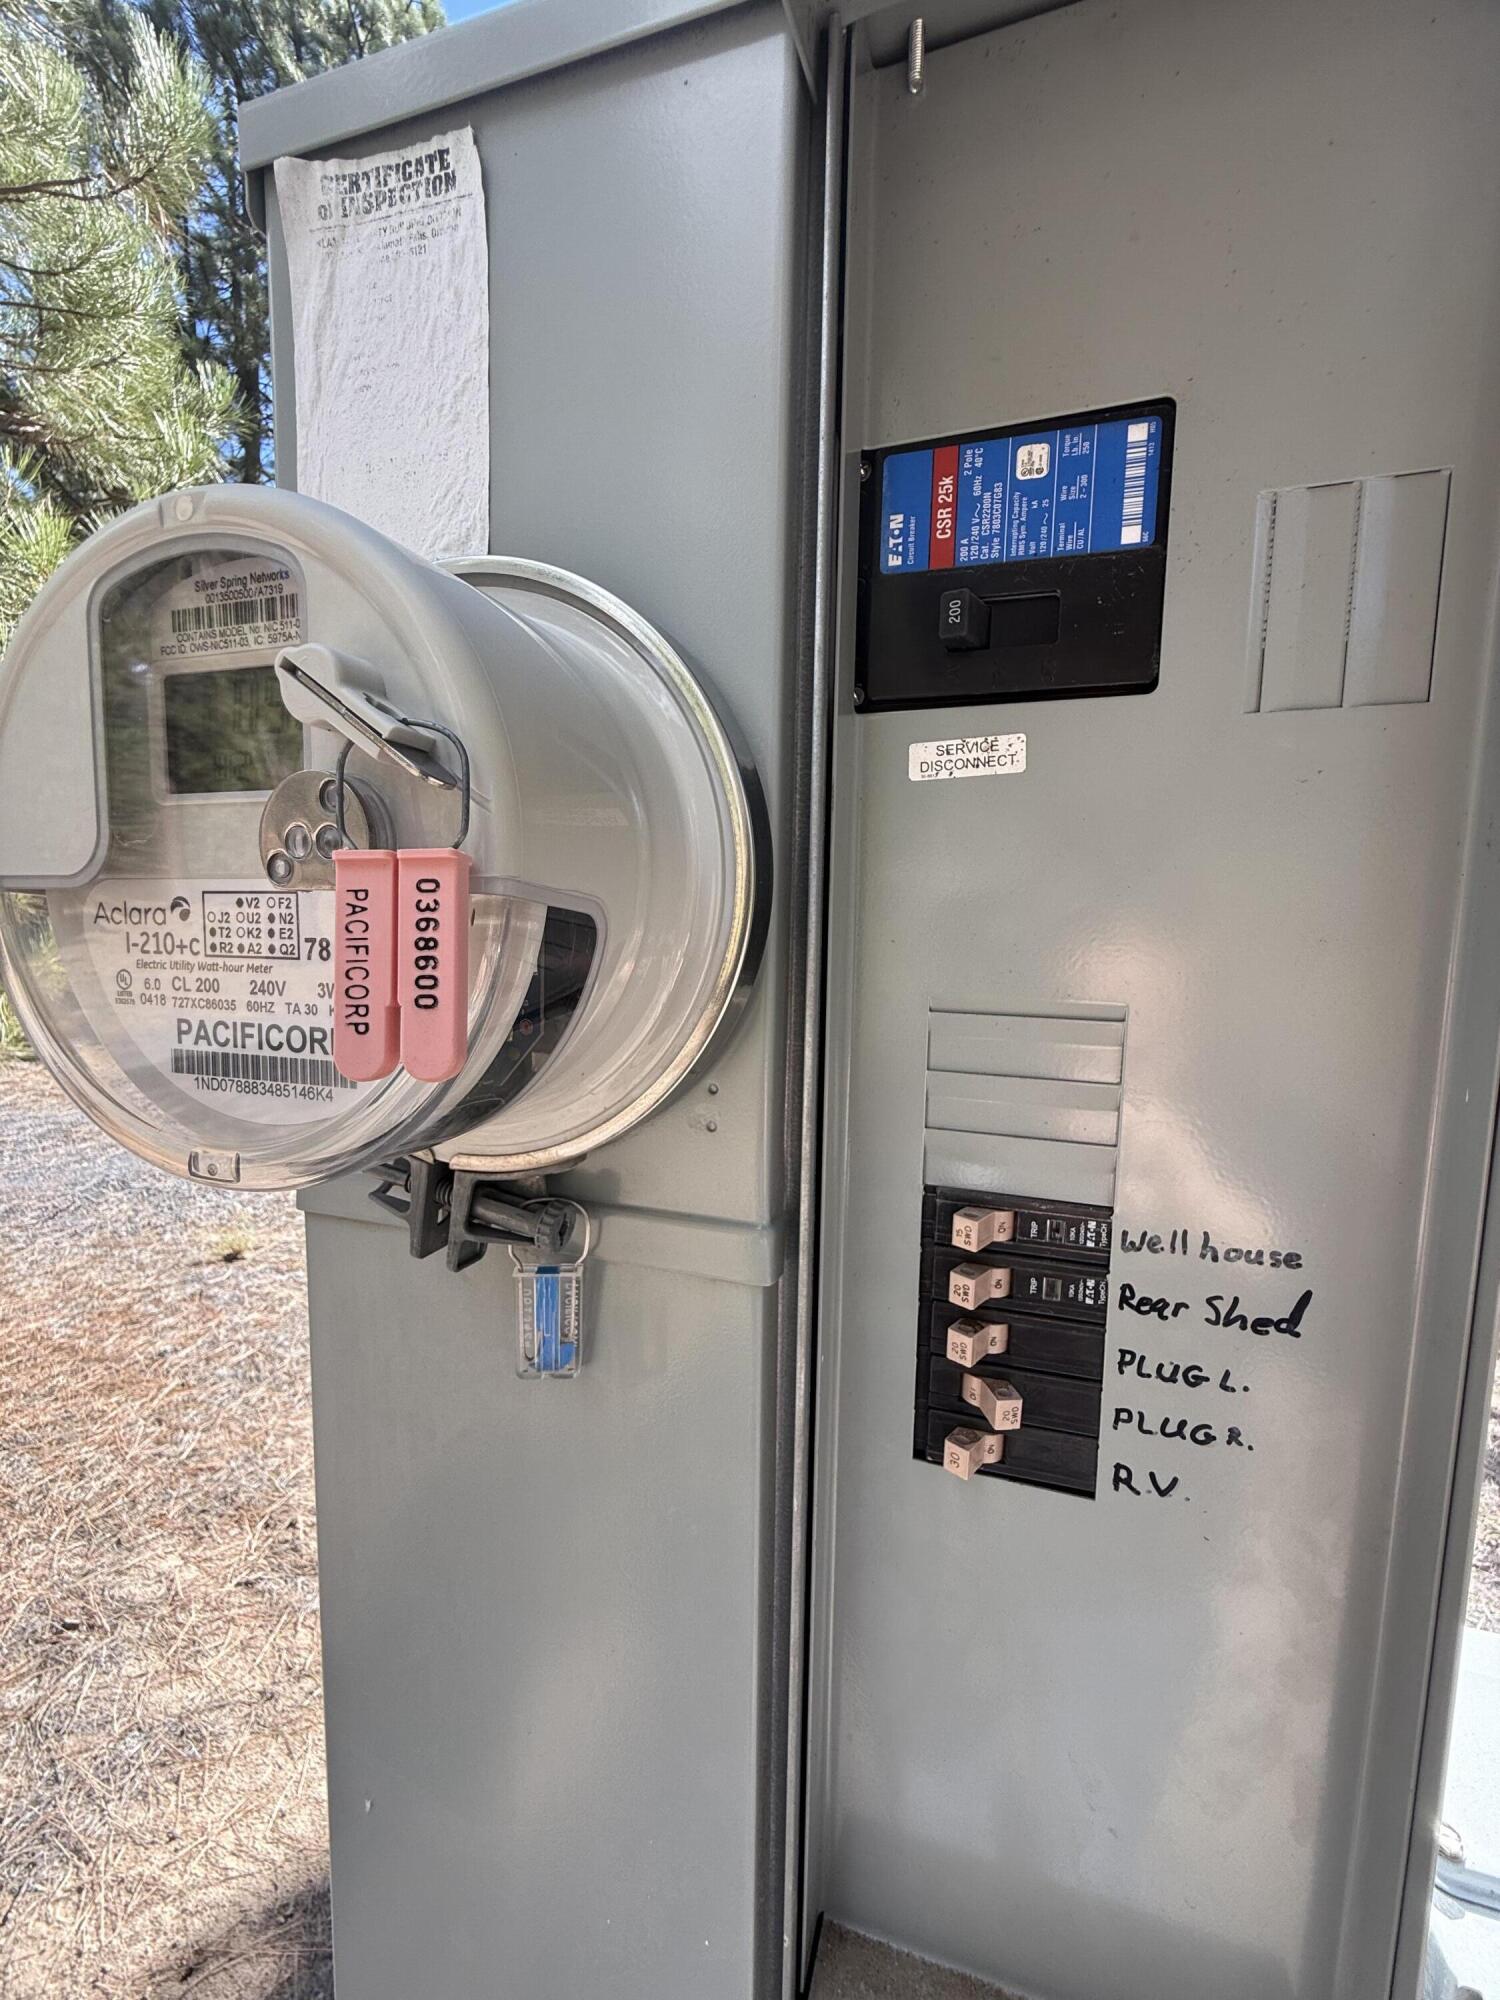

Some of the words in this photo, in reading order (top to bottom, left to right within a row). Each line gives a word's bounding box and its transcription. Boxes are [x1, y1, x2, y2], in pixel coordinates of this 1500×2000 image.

[320, 147, 451, 197] CERTIFICATE
[341, 169, 457, 219] INSPECTION
[1062, 434, 1072, 456] Torque
[964, 449, 973, 468] Pole
[974, 447, 984, 468] 40°C
[938, 475, 954, 502] 25k
[973, 475, 982, 496] 60Hz
[1060, 486, 1068, 500] Wire
[1068, 486, 1077, 500] Size
[1077, 528, 1085, 549] CU/AL
[1082, 441, 1090, 454] 250
[982, 492, 992, 535] CSR2200N
[992, 482, 1003, 534] 7803C07G83
[1012, 492, 1021, 518] Capacity
[1020, 497, 1029, 521] Ampere
[1030, 500, 1038, 508] kA
[1042, 499, 1049, 507] 25
[908, 516, 916, 541] Breaker
[936, 508, 952, 539] CSR
[888, 514, 904, 566] EATON
[970, 526, 980, 560] 120/240
[1010, 520, 1020, 556] Interrupting
[1039, 526, 1048, 552] 120/240
[1056, 523, 1066, 550] Terminal
[1066, 534, 1074, 550] Wire
[907, 543, 916, 564] Circuit
[960, 546, 968, 561] 200
[980, 543, 990, 559] Cat.
[991, 538, 1001, 558] Style
[1018, 540, 1026, 555] RMS
[1029, 541, 1037, 554] Volt
[194, 580, 218, 592] Silver
[220, 575, 248, 590] Spring
[250, 568, 290, 584] Networks
[949, 600, 961, 623] 200
[176, 630, 218, 643] CONTAINS
[219, 626, 248, 638] MODEL
[160, 646, 178, 656] FCC
[936, 739, 1000, 757] SERVICE
[920, 753, 1017, 773] DISCONNECT
[94, 900, 166, 926] Aclara
[246, 896, 260, 909] V2
[278, 896, 292, 910] F2
[218, 912, 231, 924] J2
[246, 912, 262, 924] U2
[279, 912, 294, 925] N2
[218, 926, 232, 939] T2
[247, 927, 262, 939] K2
[279, 928, 294, 940] E2
[220, 942, 234, 954] R2
[247, 942, 262, 954] A2
[279, 944, 296, 956] Q2
[304, 938, 332, 962] 78
[414, 878, 441, 1010] 0368600
[136, 959, 168, 970] Electric
[170, 960, 195, 973] Utility
[198, 961, 244, 973] Watt-hour
[246, 963, 274, 974] Meter
[344, 888, 370, 1036] PACIFICORP
[144, 977, 161, 990] 6.0
[172, 976, 192, 992] CL
[196, 978, 220, 994] 200
[250, 980, 286, 997] 240V
[140, 992, 167, 1006] 0418
[172, 996, 236, 1012] 727XC86035
[246, 1000, 276, 1014] 60HZ
[285, 1002, 302, 1015] TA
[304, 1004, 318, 1016] 30
[176, 1018, 334, 1057] PACIFICOR
[194, 1076, 334, 1102] 1ND078883485146K4
[956, 1229, 964, 1237] 15
[964, 1225, 972, 1246] SWD
[998, 1222, 1006, 1234] ON
[1030, 1221, 1038, 1238] TRIP
[1086, 1221, 1097, 1247] EATON
[1200, 1231, 1304, 1270] house
[954, 1284, 962, 1297] 20
[962, 1284, 970, 1303] SWD
[995, 1279, 1002, 1289] ON
[1030, 1277, 1038, 1294] TRIP
[1085, 1279, 1095, 1304] EATON
[1118, 1283, 1190, 1321] Rear
[1204, 1289, 1313, 1338] Shed
[952, 1342, 959, 1355] 20
[959, 1342, 968, 1360] SWD
[990, 1336, 997, 1346] ON
[1116, 1347, 1210, 1388] PLUG
[1002, 1410, 1010, 1421] 20
[1011, 1406, 1019, 1425] SWD
[1112, 1407, 1218, 1447] PLUG
[987, 1444, 995, 1454] ON
[950, 1452, 960, 1468] 30
